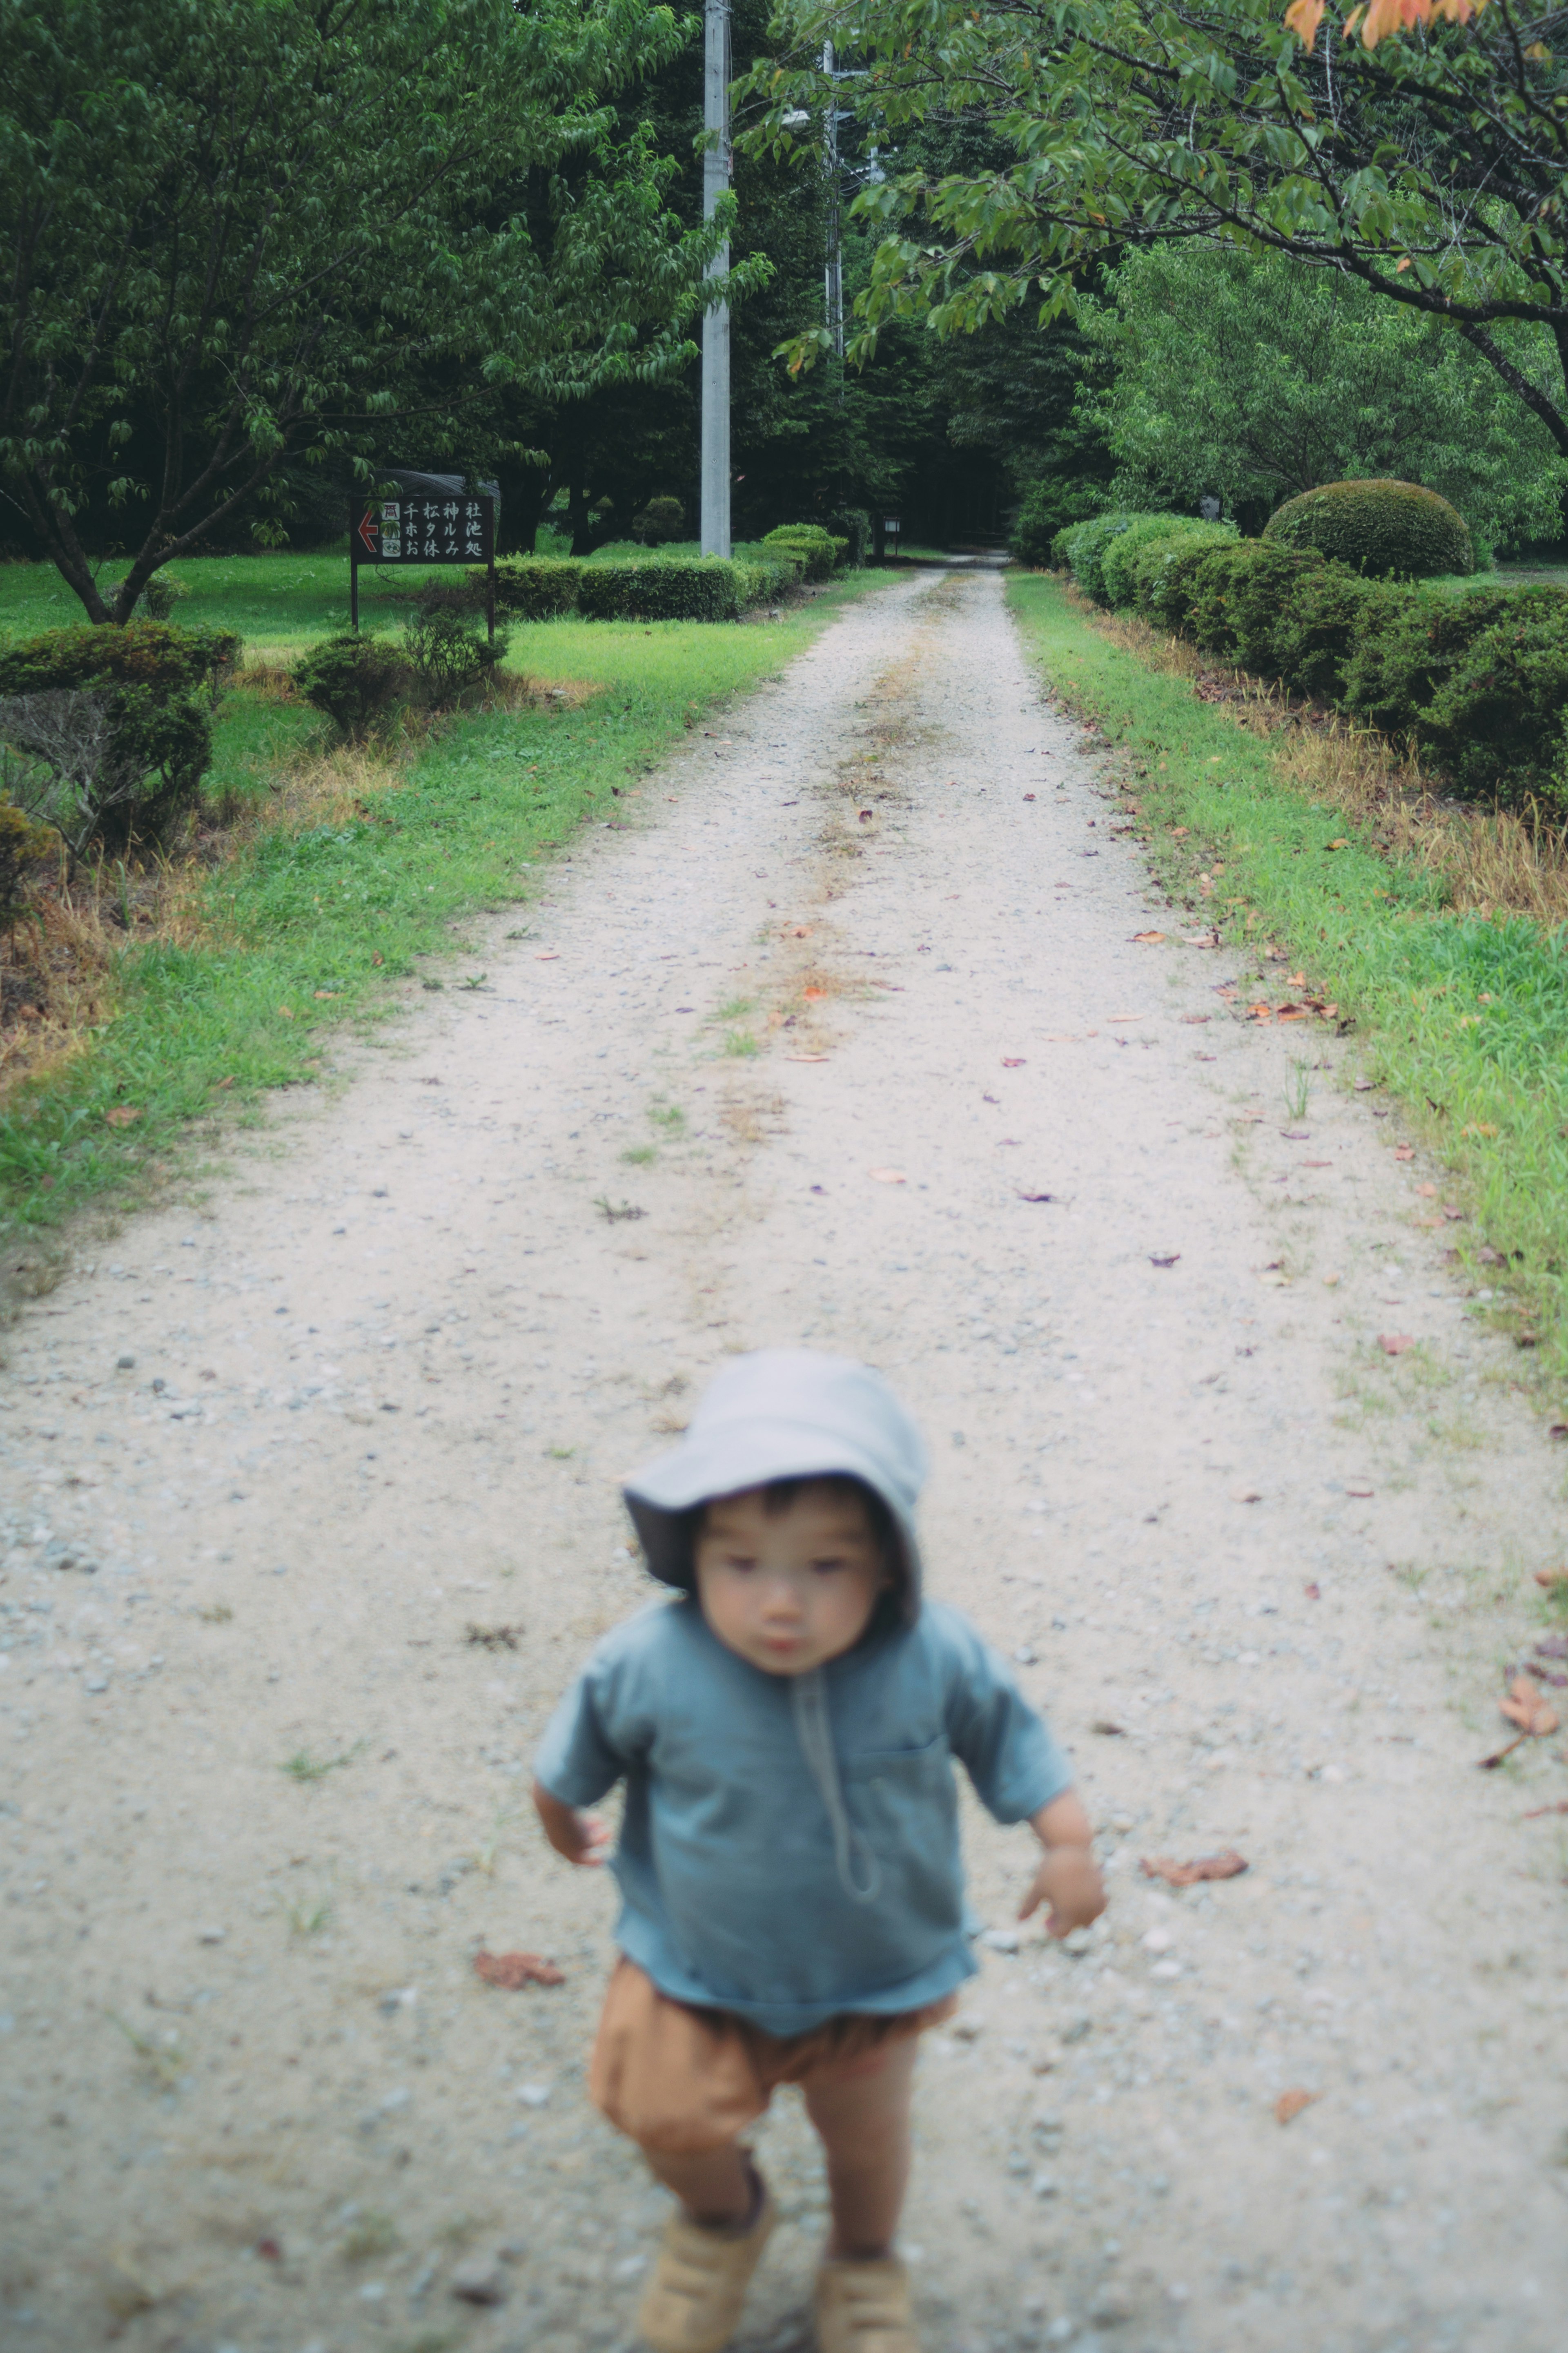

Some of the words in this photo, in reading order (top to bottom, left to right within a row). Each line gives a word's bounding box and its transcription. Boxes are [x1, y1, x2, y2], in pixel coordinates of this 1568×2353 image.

[403, 502, 482, 521] 千松神社
[406, 522, 482, 537] ホタル池
[406, 540, 482, 557] お休み処
